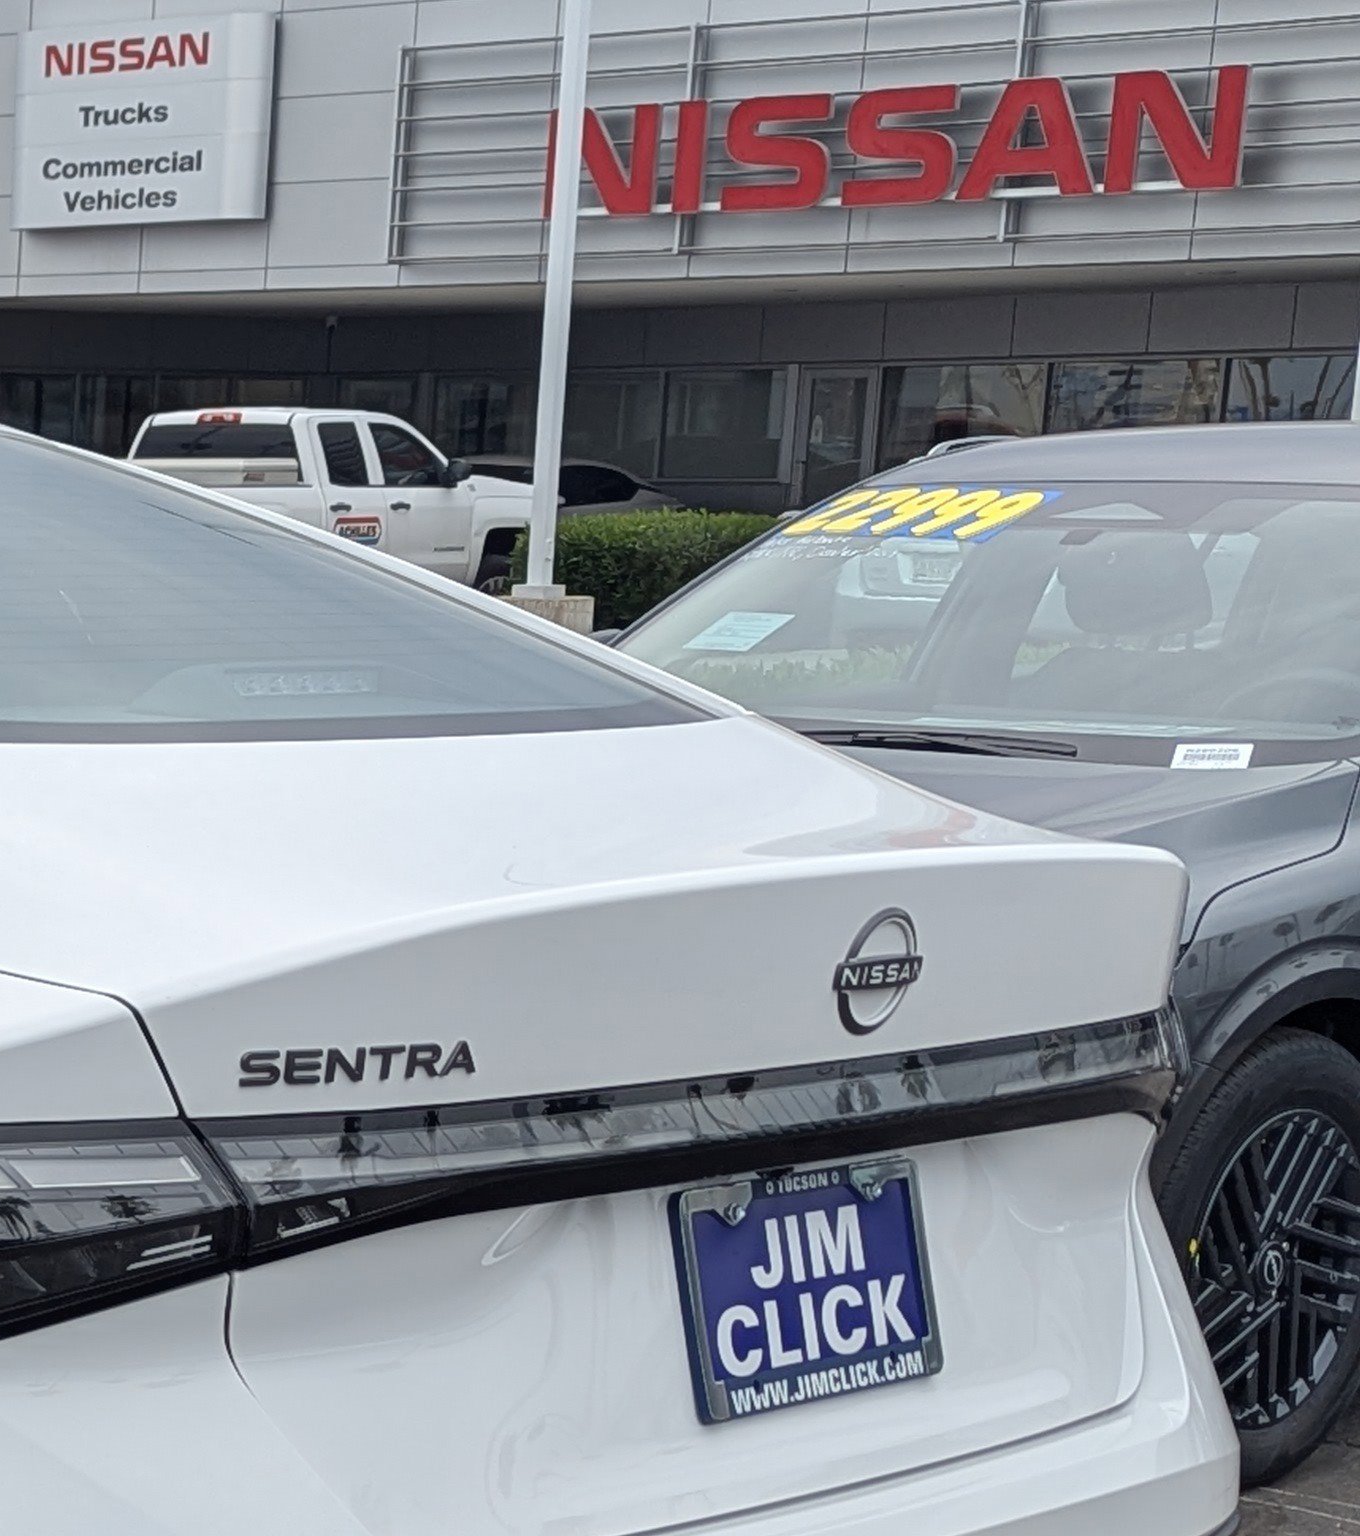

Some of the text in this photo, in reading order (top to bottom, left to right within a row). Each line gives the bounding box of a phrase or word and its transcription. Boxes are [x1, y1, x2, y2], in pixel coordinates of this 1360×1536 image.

[44, 31, 210, 78] NISSAN
[79, 102, 169, 128] Trucks
[42, 149, 203, 180] Commercial
[543, 65, 1248, 218] NISSAN
[63, 187, 178, 213] Vehicles
[782, 487, 1044, 540] 22999
[840, 961, 921, 987] NISSAN
[238, 1041, 476, 1088] SENTRA
[750, 1204, 865, 1290] JIM
[716, 1273, 916, 1378] CLICK
[730, 1350, 925, 1415] WWW.JIMCLICK.COM
